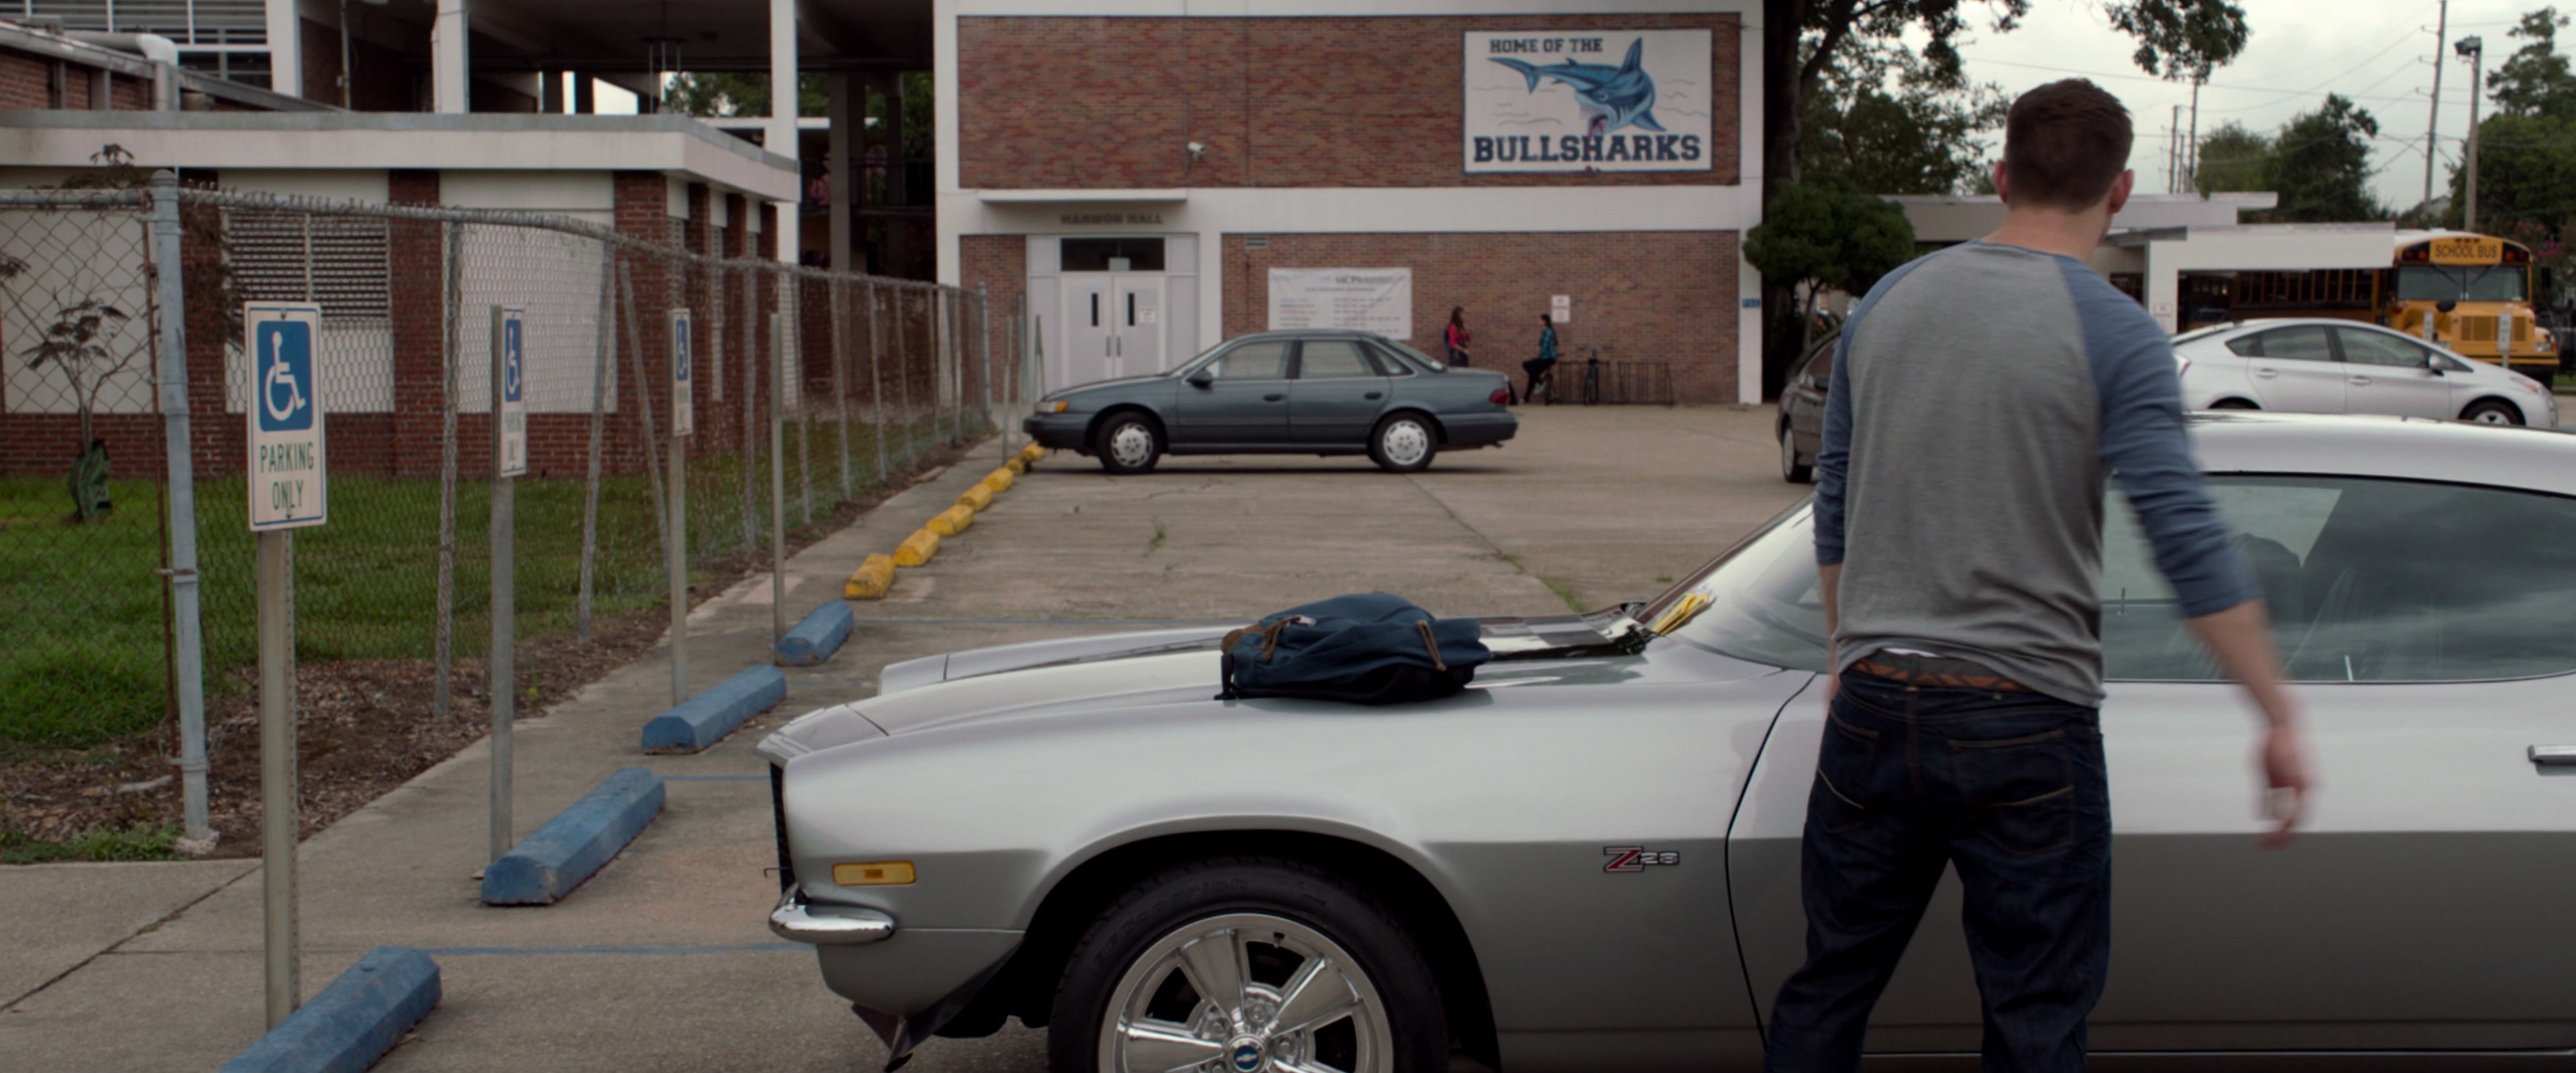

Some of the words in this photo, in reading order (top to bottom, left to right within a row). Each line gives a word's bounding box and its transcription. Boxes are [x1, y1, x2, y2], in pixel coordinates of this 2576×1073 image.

[1489, 39, 1538, 53] HOME
[1542, 38, 1564, 53] OF
[1569, 38, 1603, 52] THE
[1473, 134, 1701, 162] BULLSHARKS
[2434, 244, 2475, 258] SCHOOL
[2477, 244, 2498, 258] BUS
[259, 441, 314, 473] PARKING
[271, 479, 304, 510] ONLY
